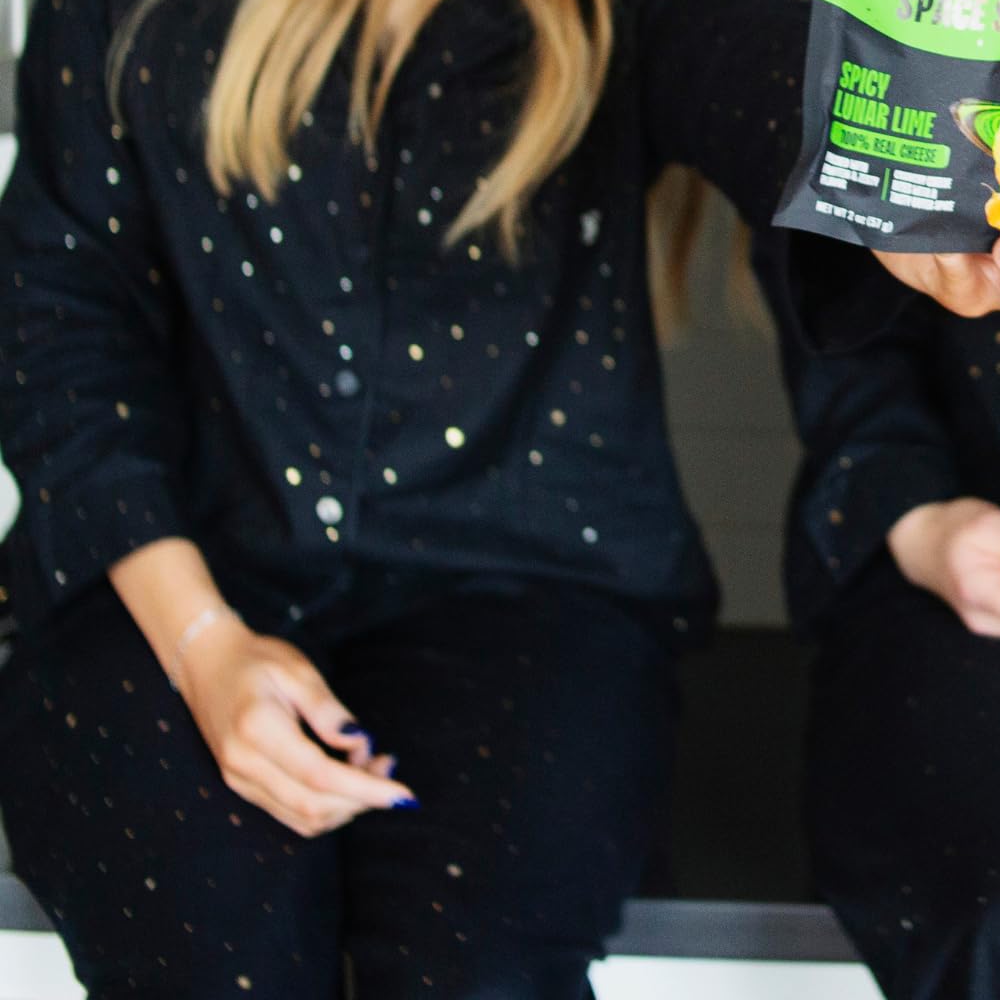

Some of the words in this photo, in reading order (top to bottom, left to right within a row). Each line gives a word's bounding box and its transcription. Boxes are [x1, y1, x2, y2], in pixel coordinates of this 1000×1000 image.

[839, 61, 891, 99] SPICY
[833, 89, 890, 130] LUNAR
[891, 105, 937, 139] LIME
[873, 137, 896, 156] REAL
[900, 141, 937, 164] CHEESE
[847, 210, 856, 222] 2
